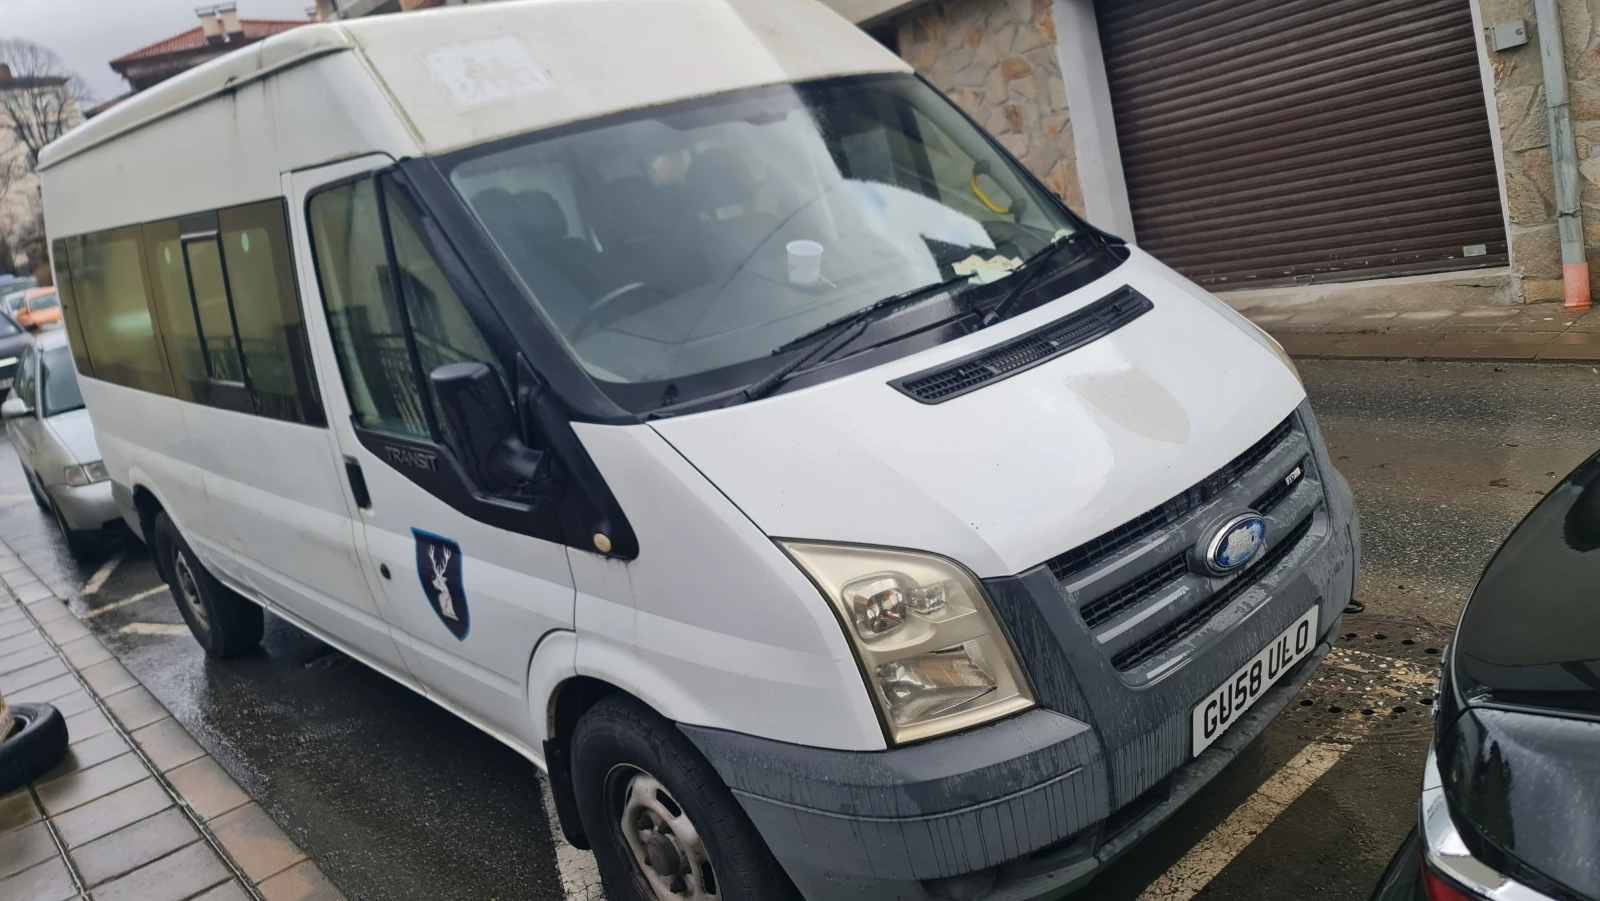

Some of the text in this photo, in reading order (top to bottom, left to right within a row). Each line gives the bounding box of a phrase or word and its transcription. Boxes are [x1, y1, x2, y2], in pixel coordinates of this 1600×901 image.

[384, 445, 437, 472] TRANSIT
[1204, 619, 1309, 739] GU58 ULO
